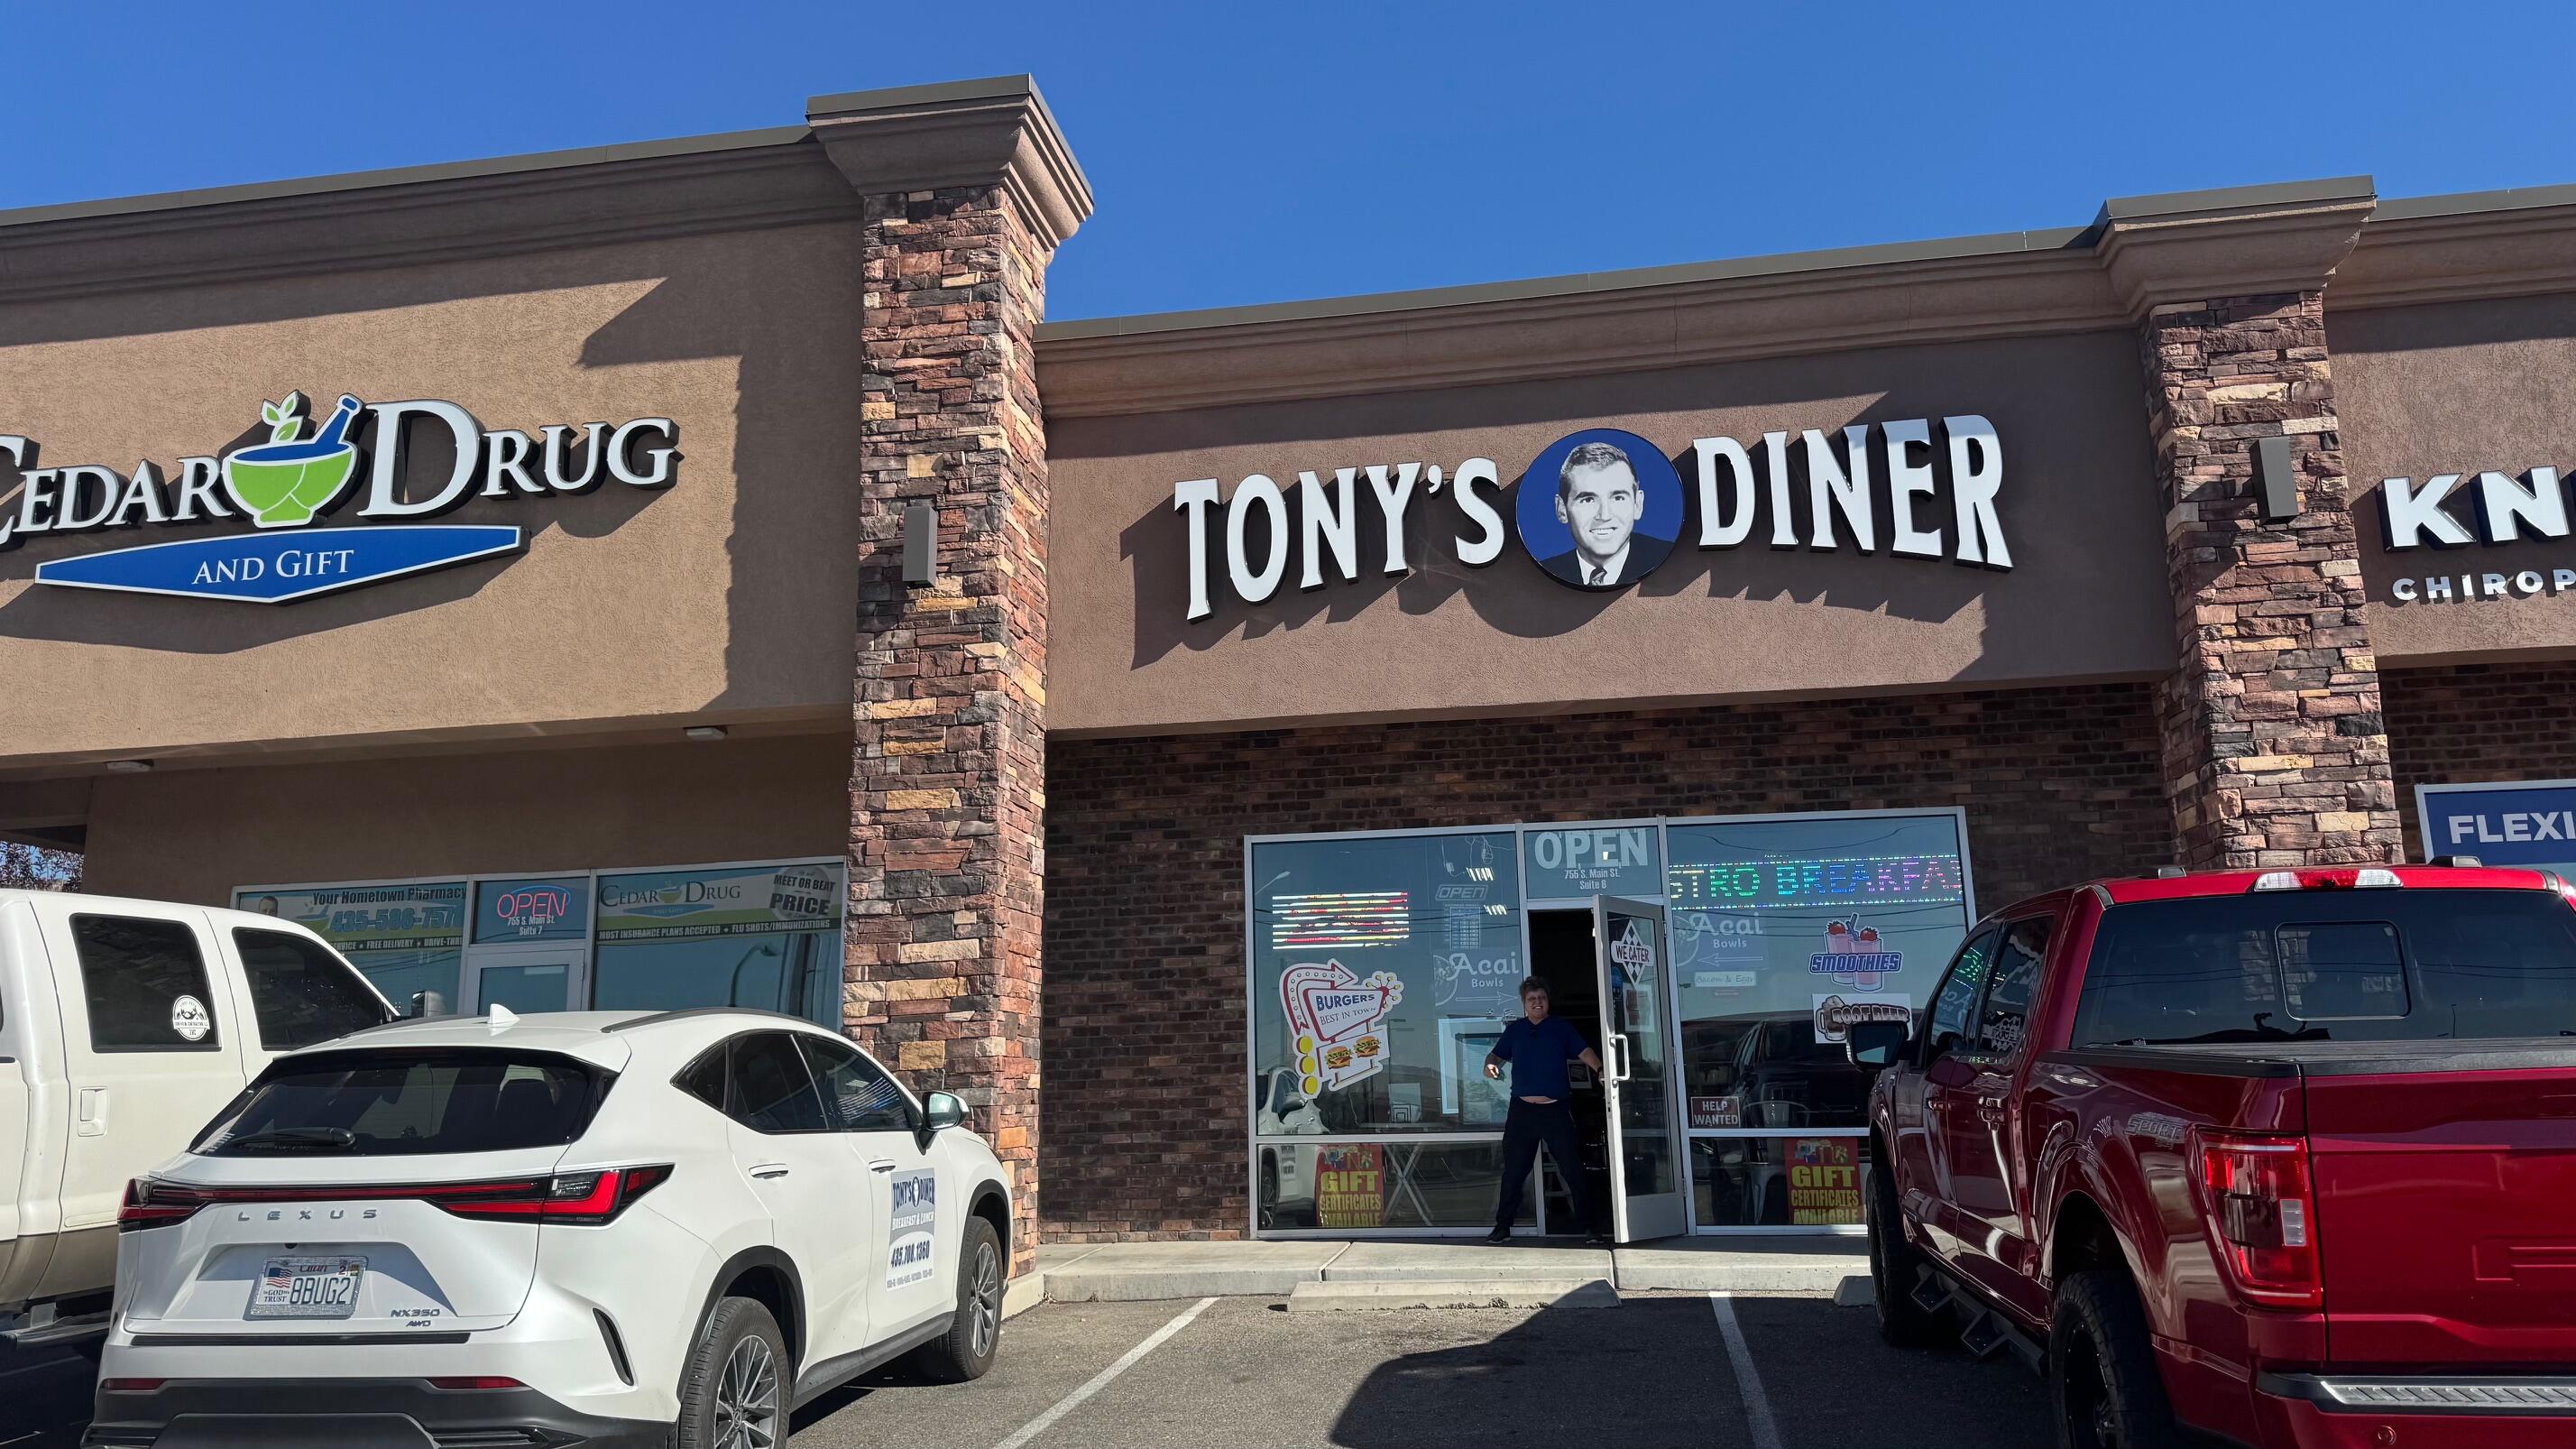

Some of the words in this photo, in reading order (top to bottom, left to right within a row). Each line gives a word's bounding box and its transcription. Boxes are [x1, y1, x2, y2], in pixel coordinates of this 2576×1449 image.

[0, 435, 236, 544] EDAR
[357, 399, 675, 517] DRUG
[2383, 466, 2576, 549] KN
[1173, 457, 1504, 623] TONY'S
[1694, 414, 2013, 571] DINER
[192, 558, 264, 586] AND
[275, 549, 354, 579] GIFT
[2392, 568, 2576, 601] CHIROP
[2448, 811, 2576, 844] FLEXI
[1534, 826, 1649, 870] OPEN
[773, 874, 798, 887] MEET
[798, 877, 811, 889] OR
[812, 879, 837, 892] BEAT
[1564, 869, 1579, 879] 755
[1580, 870, 1587, 878] S.
[1589, 868, 1608, 878] Main
[1609, 868, 1621, 877] St.
[312, 890, 340, 907] Your
[341, 885, 406, 905] Hometown
[407, 881, 467, 902] Pharmacy
[599, 884, 658, 908] CEDAR
[684, 881, 741, 903] DRUG
[1439, 887, 1486, 899] OPEN
[1579, 881, 1600, 890] Suite
[1601, 880, 1607, 889] 6
[497, 891, 567, 918] OPEN
[768, 892, 832, 916] PRICE
[599, 929, 620, 940] MOST
[621, 927, 661, 939] INSURANCE
[661, 926, 685, 937] PLANS
[685, 923, 722, 936] ACCEPTED
[731, 922, 748, 933] FLU
[1687, 911, 1763, 942] Acai
[366, 938, 384, 950] FREE
[382, 937, 414, 949] DELIVERY
[424, 935, 464, 947] DRIVE-THR
[1713, 938, 1747, 948] Bowls
[1615, 945, 1627, 960] WE
[1628, 946, 1650, 963] CATER
[1811, 954, 1900, 971] SMOOTHIES
[1447, 951, 1520, 981] Acai
[1471, 977, 1504, 988] Bowls
[1316, 994, 1375, 1011] BURGERS
[1320, 1012, 1340, 1025] BEST
[1341, 1011, 1350, 1020] IN
[1353, 1007, 1376, 1016] TOWN
[1831, 1004, 1872, 1025] ROOT
[1702, 1101, 1728, 1112] HELP
[1694, 1114, 1738, 1126] WANTED
[2124, 1118, 2184, 1140] SPORT
[1320, 1170, 1379, 1193] GIFT
[1791, 1165, 1855, 1188] GIFT
[892, 1180, 912, 1212] TONY'S
[919, 1177, 934, 1204] DINER
[1320, 1193, 1382, 1211] CERTIFICATES
[1790, 1189, 1859, 1207] CERTIFICATES
[237, 1209, 377, 1222] LEXUS
[391, 1309, 440, 1317] NX350
